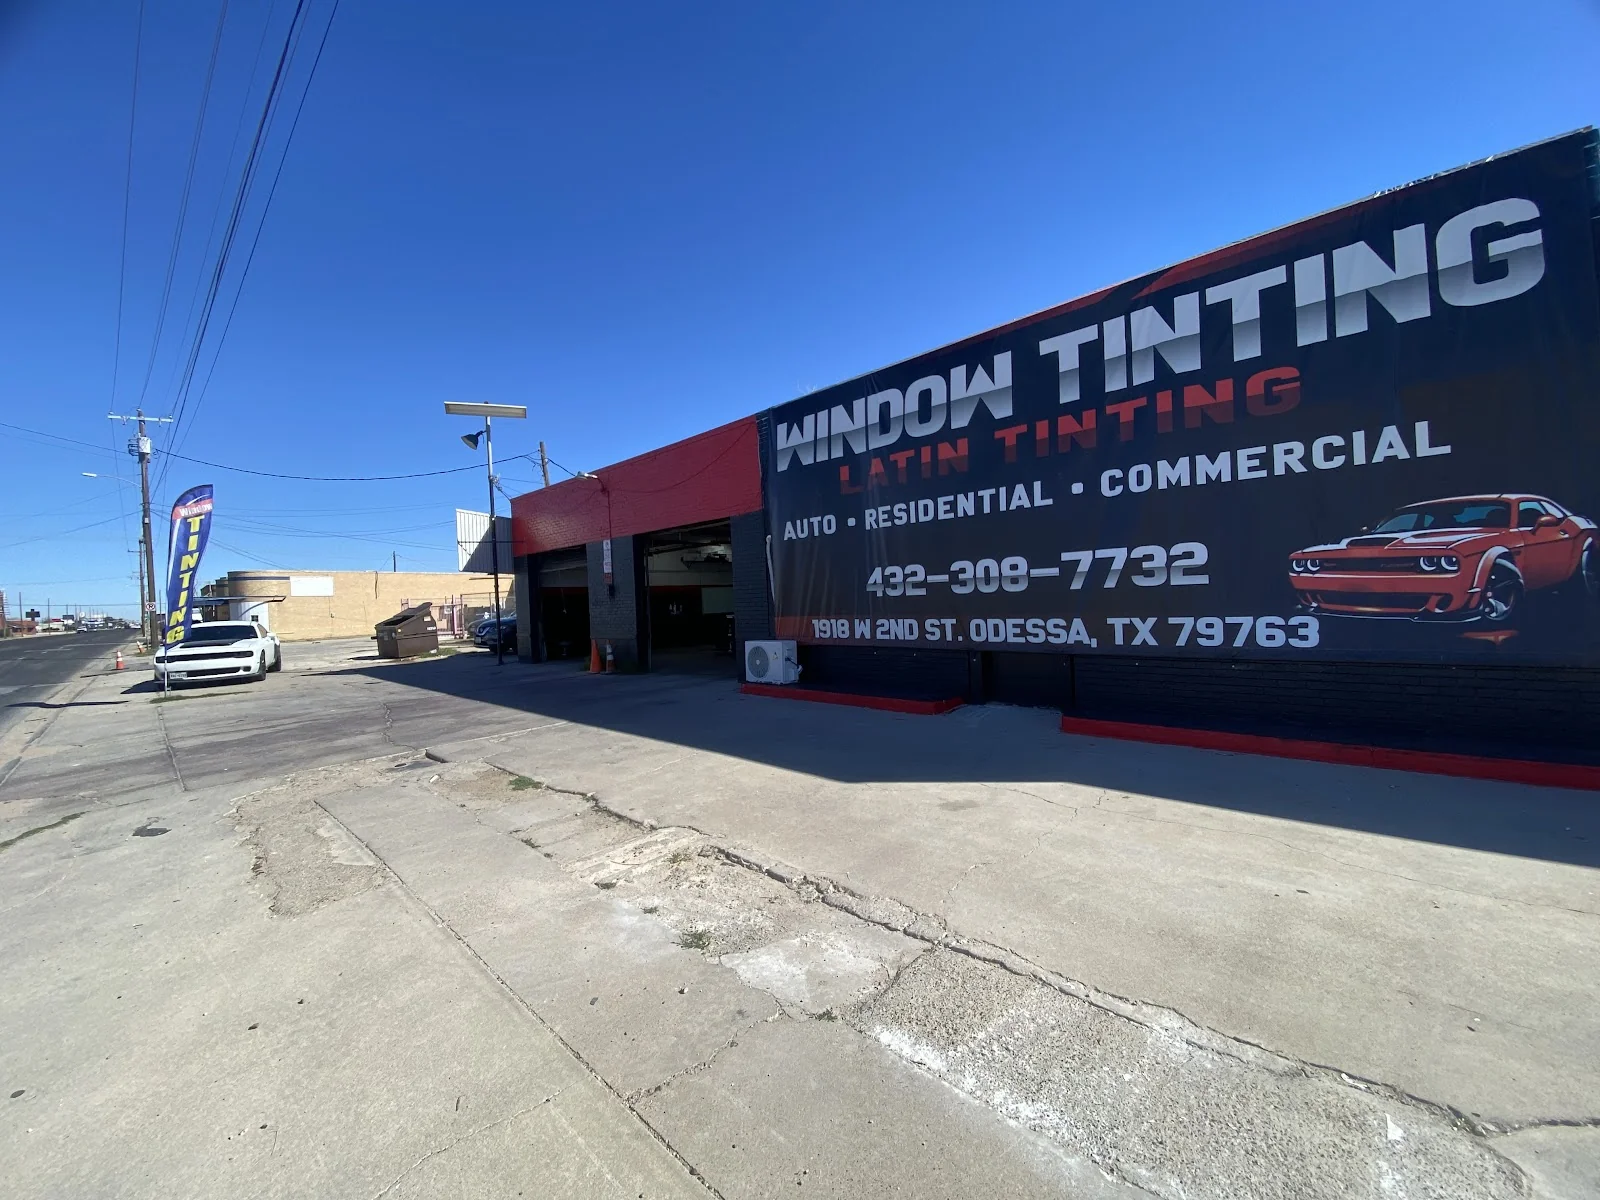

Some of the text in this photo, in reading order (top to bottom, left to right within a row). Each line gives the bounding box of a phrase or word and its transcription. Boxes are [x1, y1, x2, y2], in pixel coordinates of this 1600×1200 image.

[776, 197, 1546, 473] WINDOW TINTING
[783, 420, 1452, 541] AUTO RESIDENTIAL COMMERCIAL
[839, 366, 1301, 495] LATIN TINTING
[166, 514, 205, 644] TINTING
[866, 541, 1210, 597] 432-308-7732
[811, 616, 1320, 648] 1918 W 2ND ST. ODESSA, TX 79763
